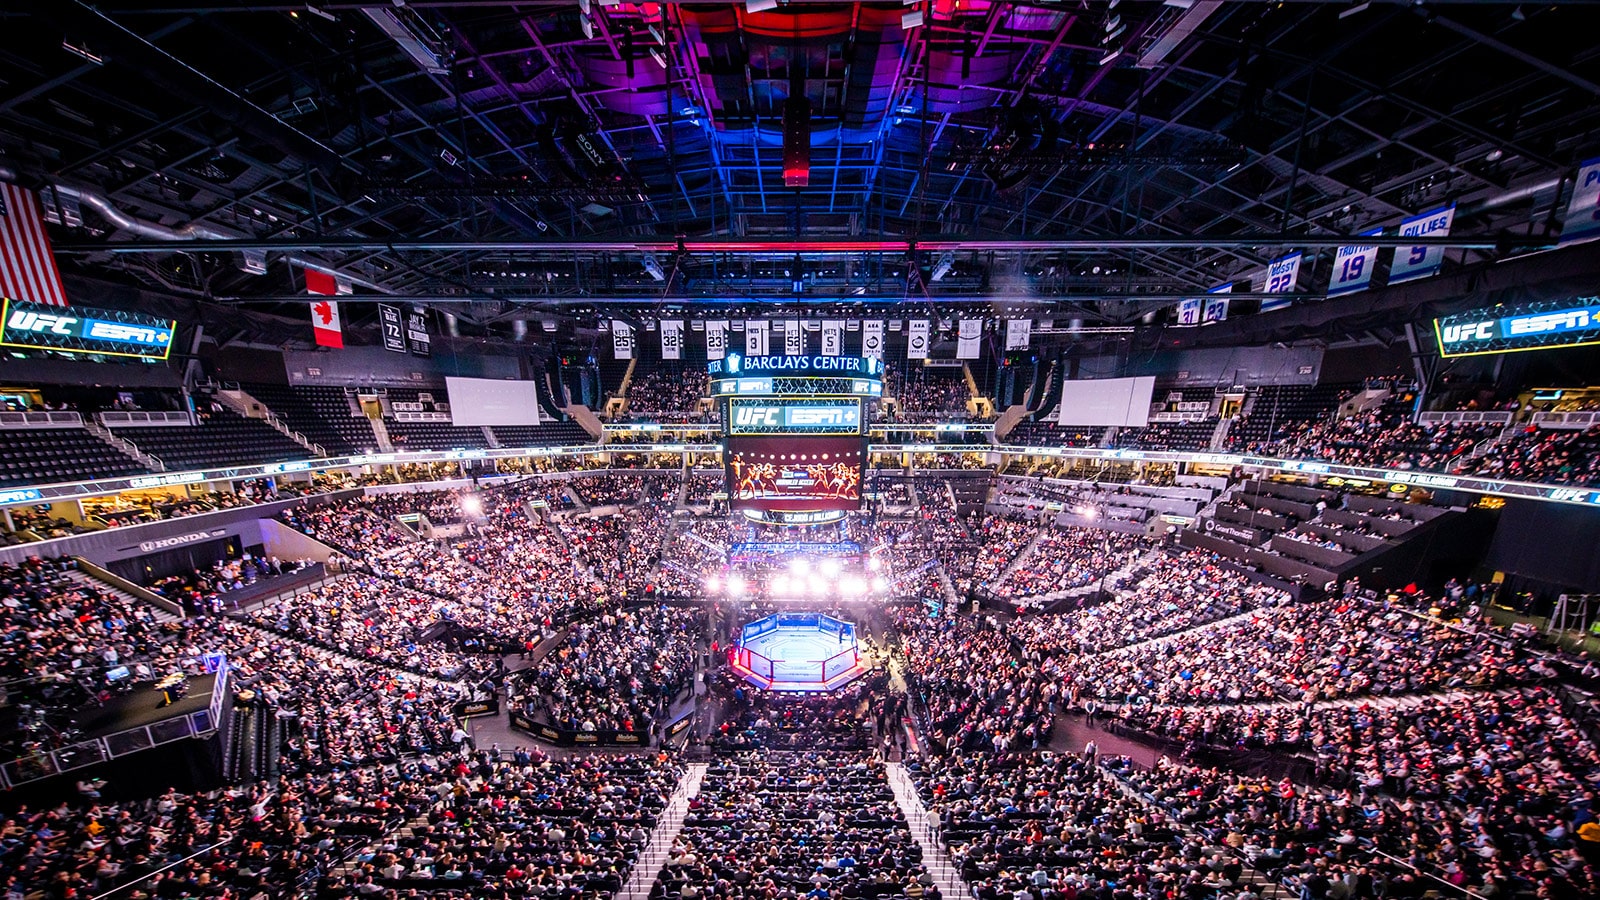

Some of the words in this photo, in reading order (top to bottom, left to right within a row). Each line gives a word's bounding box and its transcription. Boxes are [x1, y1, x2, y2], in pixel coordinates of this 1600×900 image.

[578, 134, 605, 164] SONY
[1404, 216, 1448, 236] GILLIES
[1339, 255, 1365, 283] 19
[1269, 274, 1292, 293] 22
[8, 311, 78, 335] UFC
[386, 323, 400, 337] 72
[1443, 321, 1494, 343] UFC
[615, 336, 629, 347] 25
[663, 336, 677, 347] 32
[708, 336, 722, 347] 23
[750, 337, 757, 349] 3
[826, 337, 834, 347] 5
[744, 356, 808, 370] BARCLAYS
[813, 356, 860, 370] CENTER
[736, 407, 780, 425] UFC
[1550, 489, 1588, 502] UFC
[156, 532, 210, 548] HONDA
